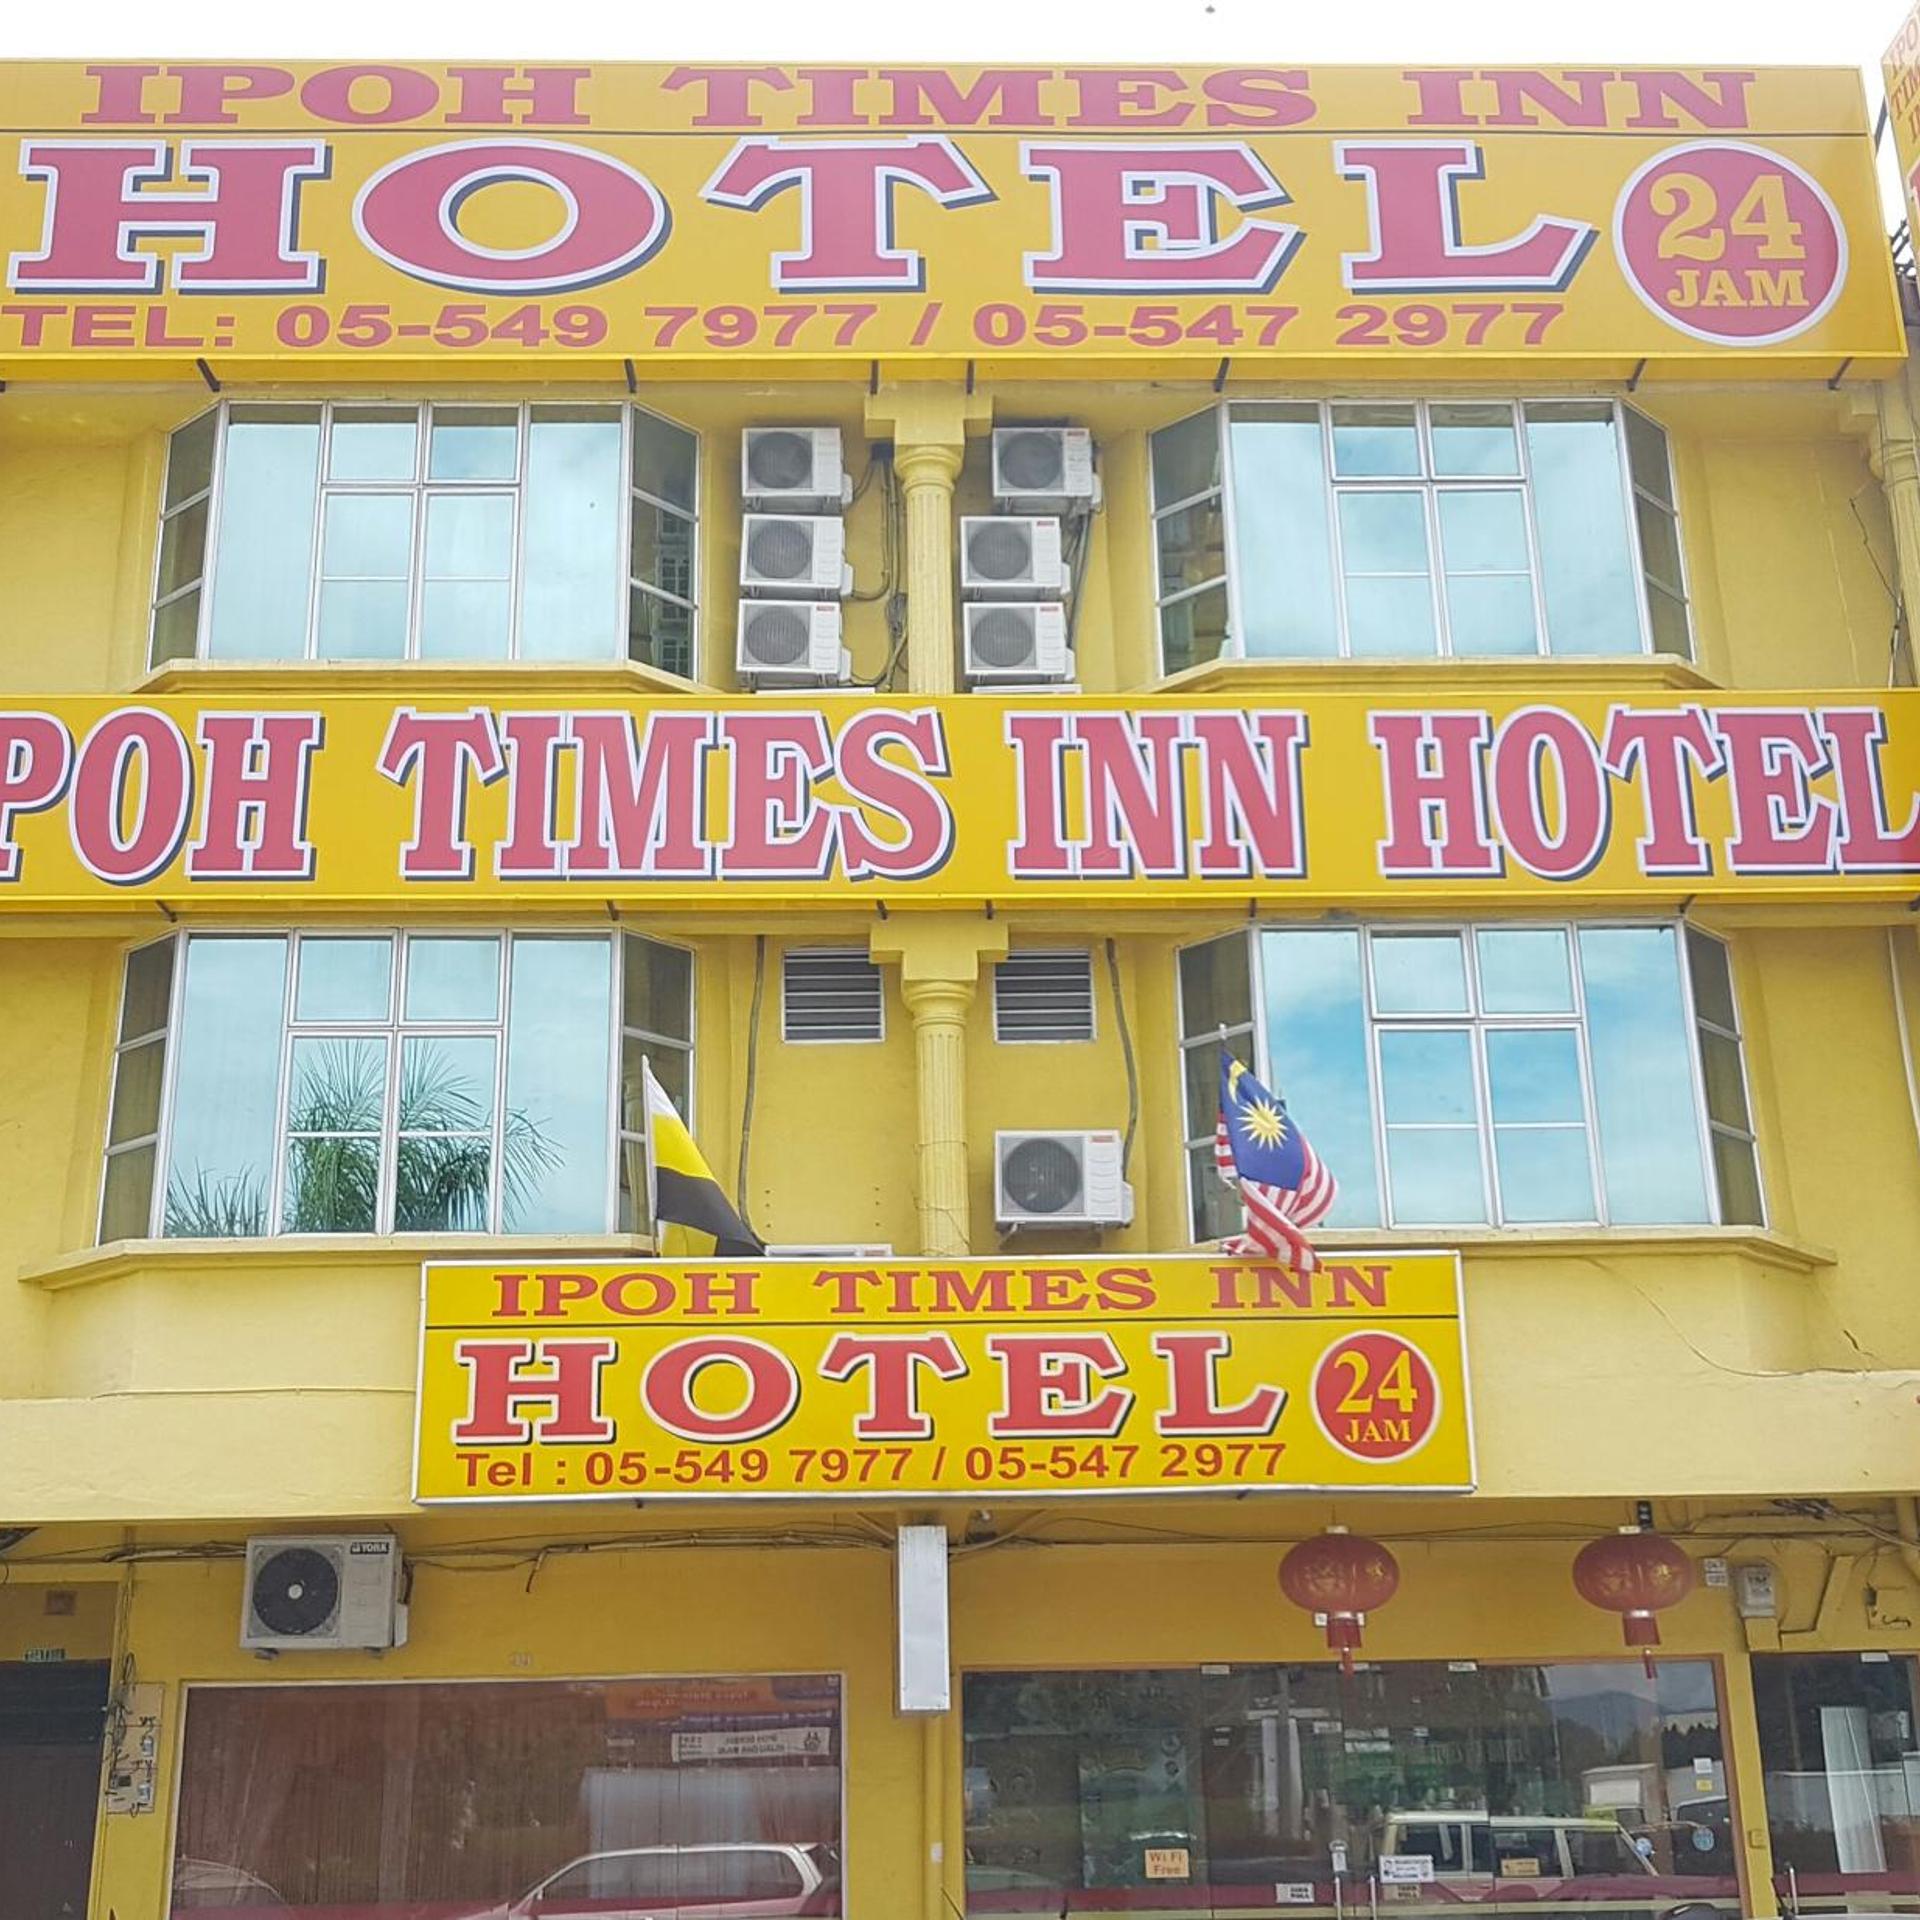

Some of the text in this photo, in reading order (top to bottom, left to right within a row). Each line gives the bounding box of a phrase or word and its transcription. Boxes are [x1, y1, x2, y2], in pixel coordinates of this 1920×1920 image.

[81, 65, 1755, 128] IPOH TIMES INN
[6, 135, 1600, 295] HOTEL
[1649, 173, 1805, 260] 24
[1667, 269, 1809, 307] JAM
[1, 302, 1563, 347] TEL: 05-549 7977 / 05-547 2977
[375, 706, 955, 882] TIMES
[1004, 711, 1309, 880] INN
[1367, 703, 1920, 881] HOTEL
[492, 1265, 1392, 1317] IPOH TIMES INN
[451, 1330, 1287, 1443] HOTEL
[1334, 1349, 1419, 1414] 24
[1345, 1418, 1413, 1443] JAM
[456, 1452, 531, 1486] Tel
[585, 1449, 768, 1485] 05-549
[788, 1448, 912, 1483] 7977
[931, 1446, 947, 1481] /
[965, 1445, 1140, 1480] 05-547
[1160, 1443, 1286, 1478] 2977
